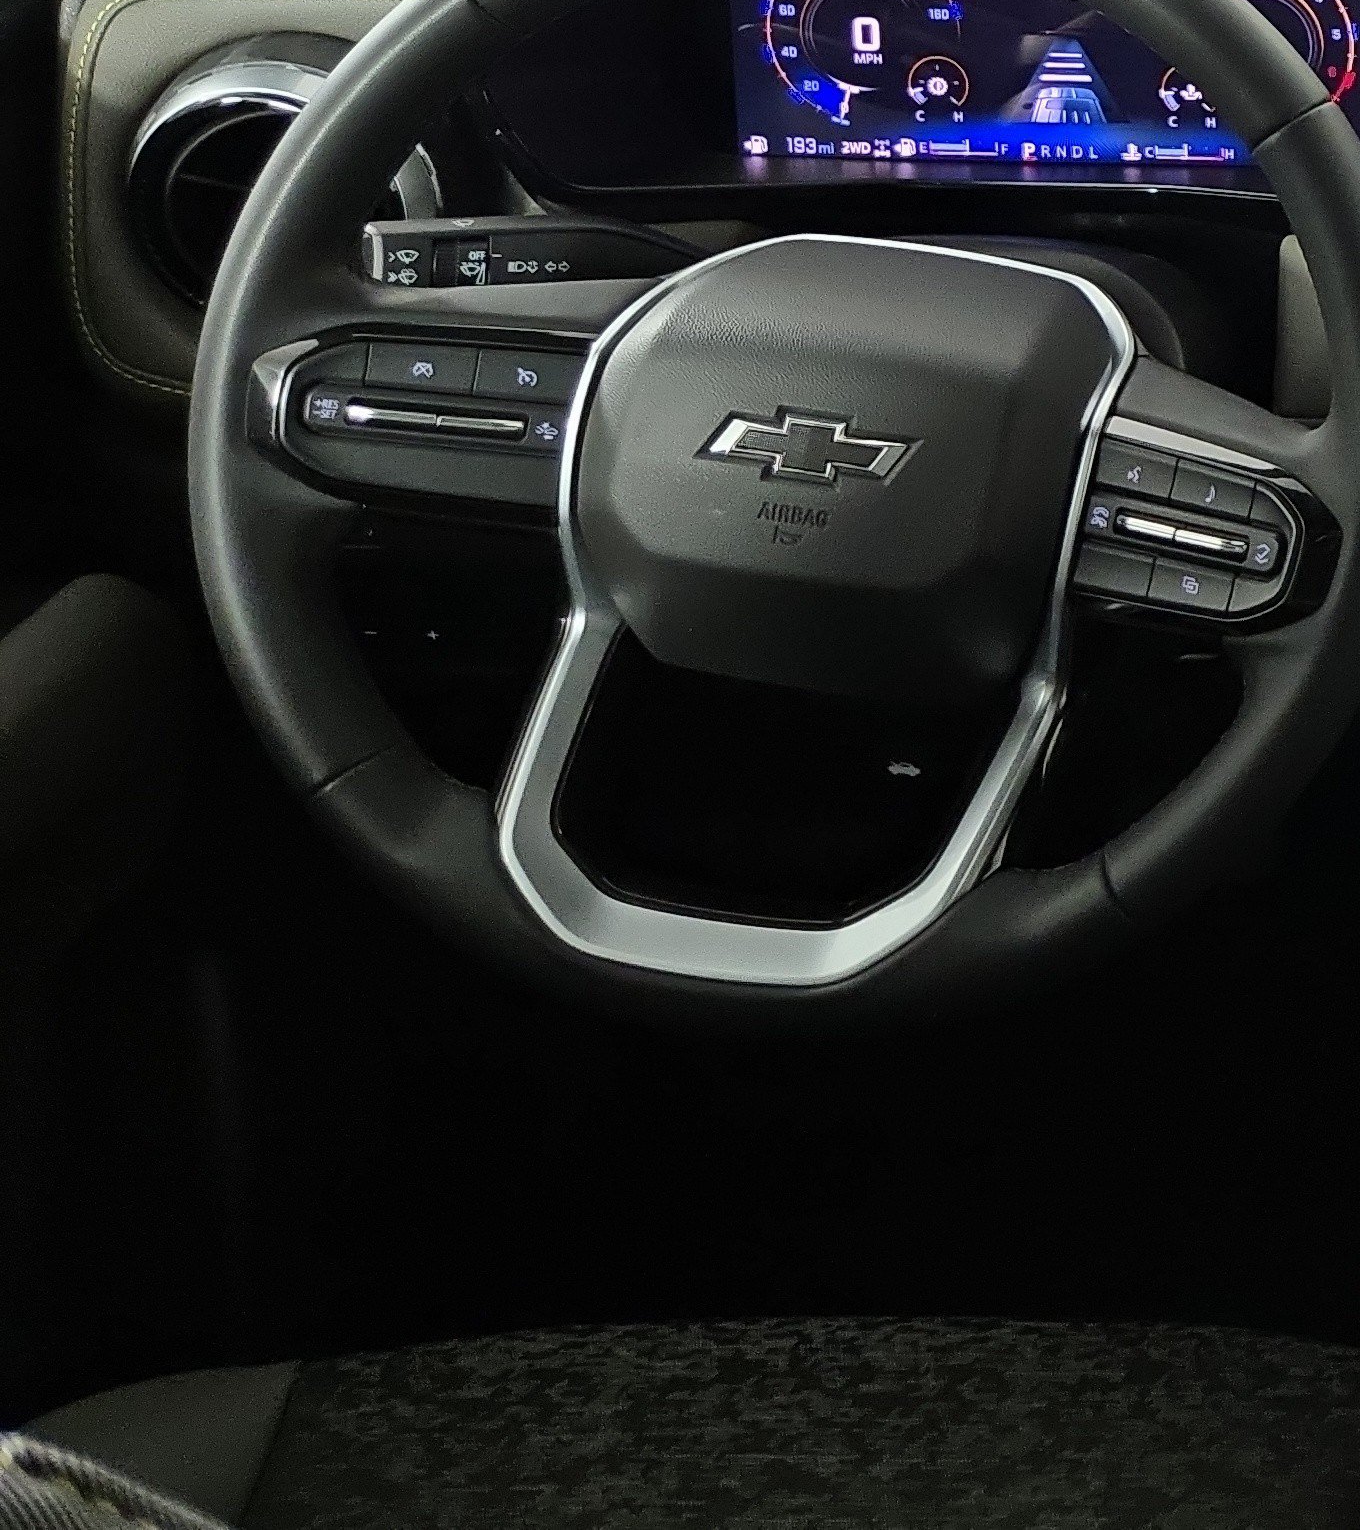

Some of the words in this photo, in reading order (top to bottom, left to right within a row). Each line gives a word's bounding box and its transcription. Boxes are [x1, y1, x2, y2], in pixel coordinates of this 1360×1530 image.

[778, 4, 796, 16] 60
[928, 8, 950, 20] 160
[852, 16, 881, 52] 0
[1332, 28, 1342, 40] 5
[780, 46, 798, 58] 40
[853, 53, 883, 65] MPH
[803, 80, 820, 92] 20
[914, 110, 926, 122] C
[953, 111, 964, 122] H
[1167, 115, 1179, 128] C
[1205, 116, 1217, 128] H
[786, 136, 817, 155] 193
[818, 142, 835, 155] mi
[840, 141, 872, 155] 2WD
[919, 141, 928, 154] E
[1001, 144, 1009, 155] F
[1022, 143, 1036, 160] P
[1041, 145, 1051, 158] R
[1056, 145, 1067, 158] N
[1072, 145, 1083, 159] D
[1089, 146, 1099, 160] L
[1145, 146, 1155, 158] C
[1224, 148, 1235, 160] H
[468, 250, 486, 261] OFF
[756, 501, 828, 528] AIRBAG
